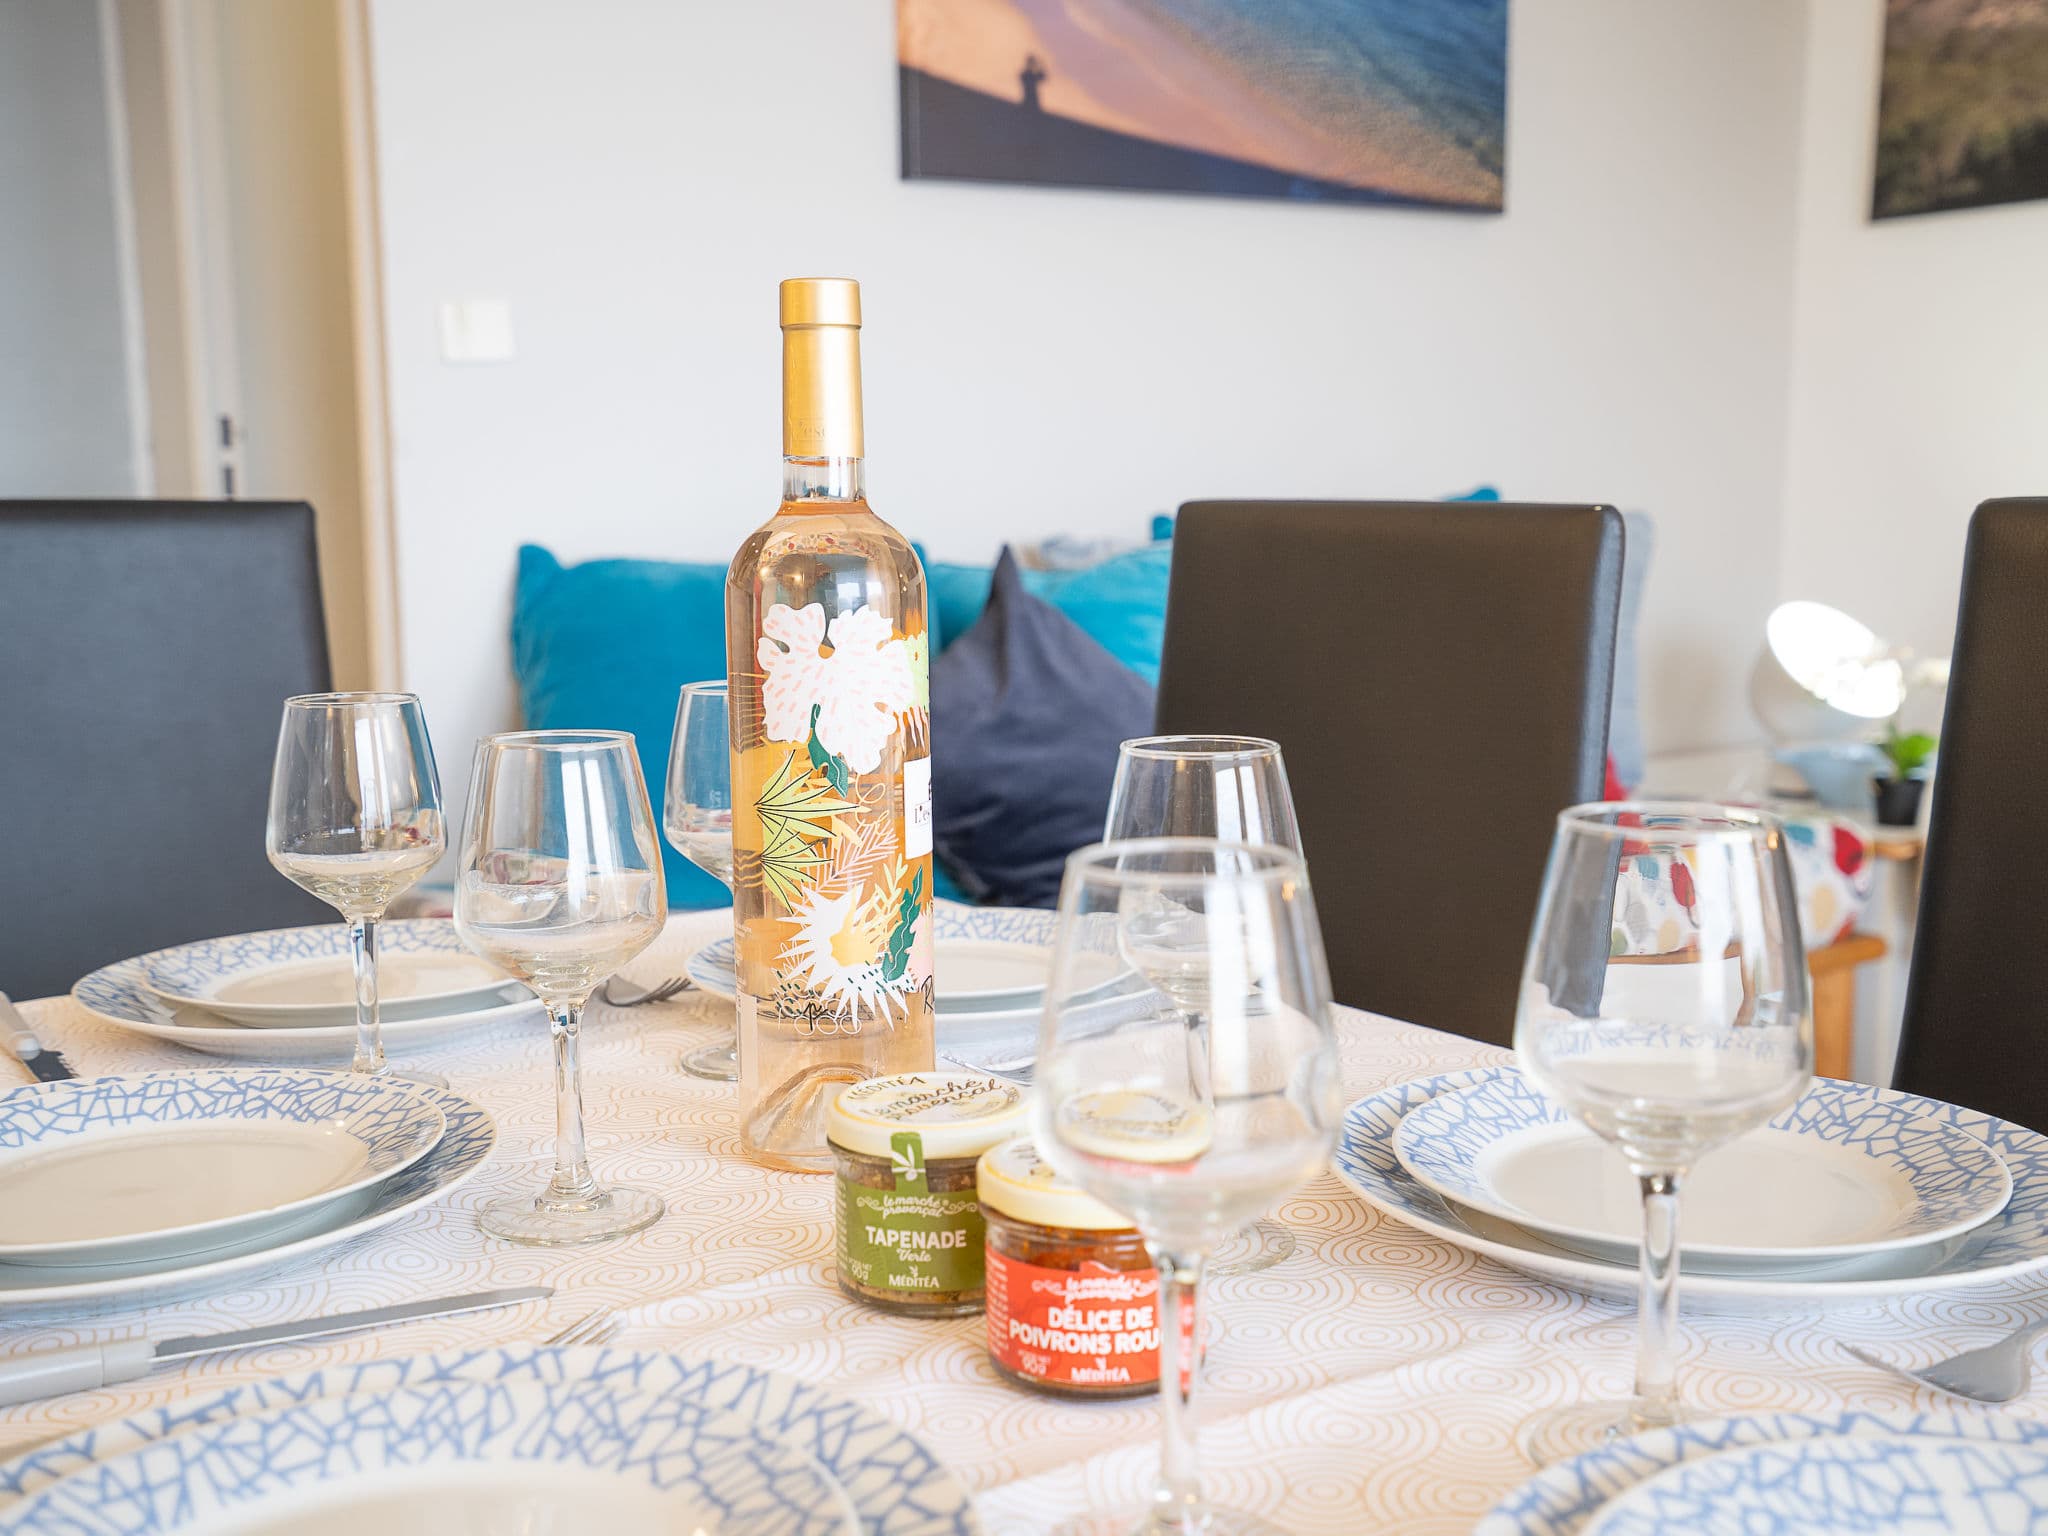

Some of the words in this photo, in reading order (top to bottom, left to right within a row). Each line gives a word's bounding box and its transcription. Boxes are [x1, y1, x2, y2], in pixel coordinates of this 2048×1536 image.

[887, 1078, 984, 1111] marché
[865, 1225, 967, 1249] TAPENADE
[1048, 1304, 1123, 1332] DÉLICE
[1125, 1306, 1154, 1330] DE
[1009, 1319, 1112, 1355] POIVRONS
[1114, 1328, 1163, 1354] ROU
